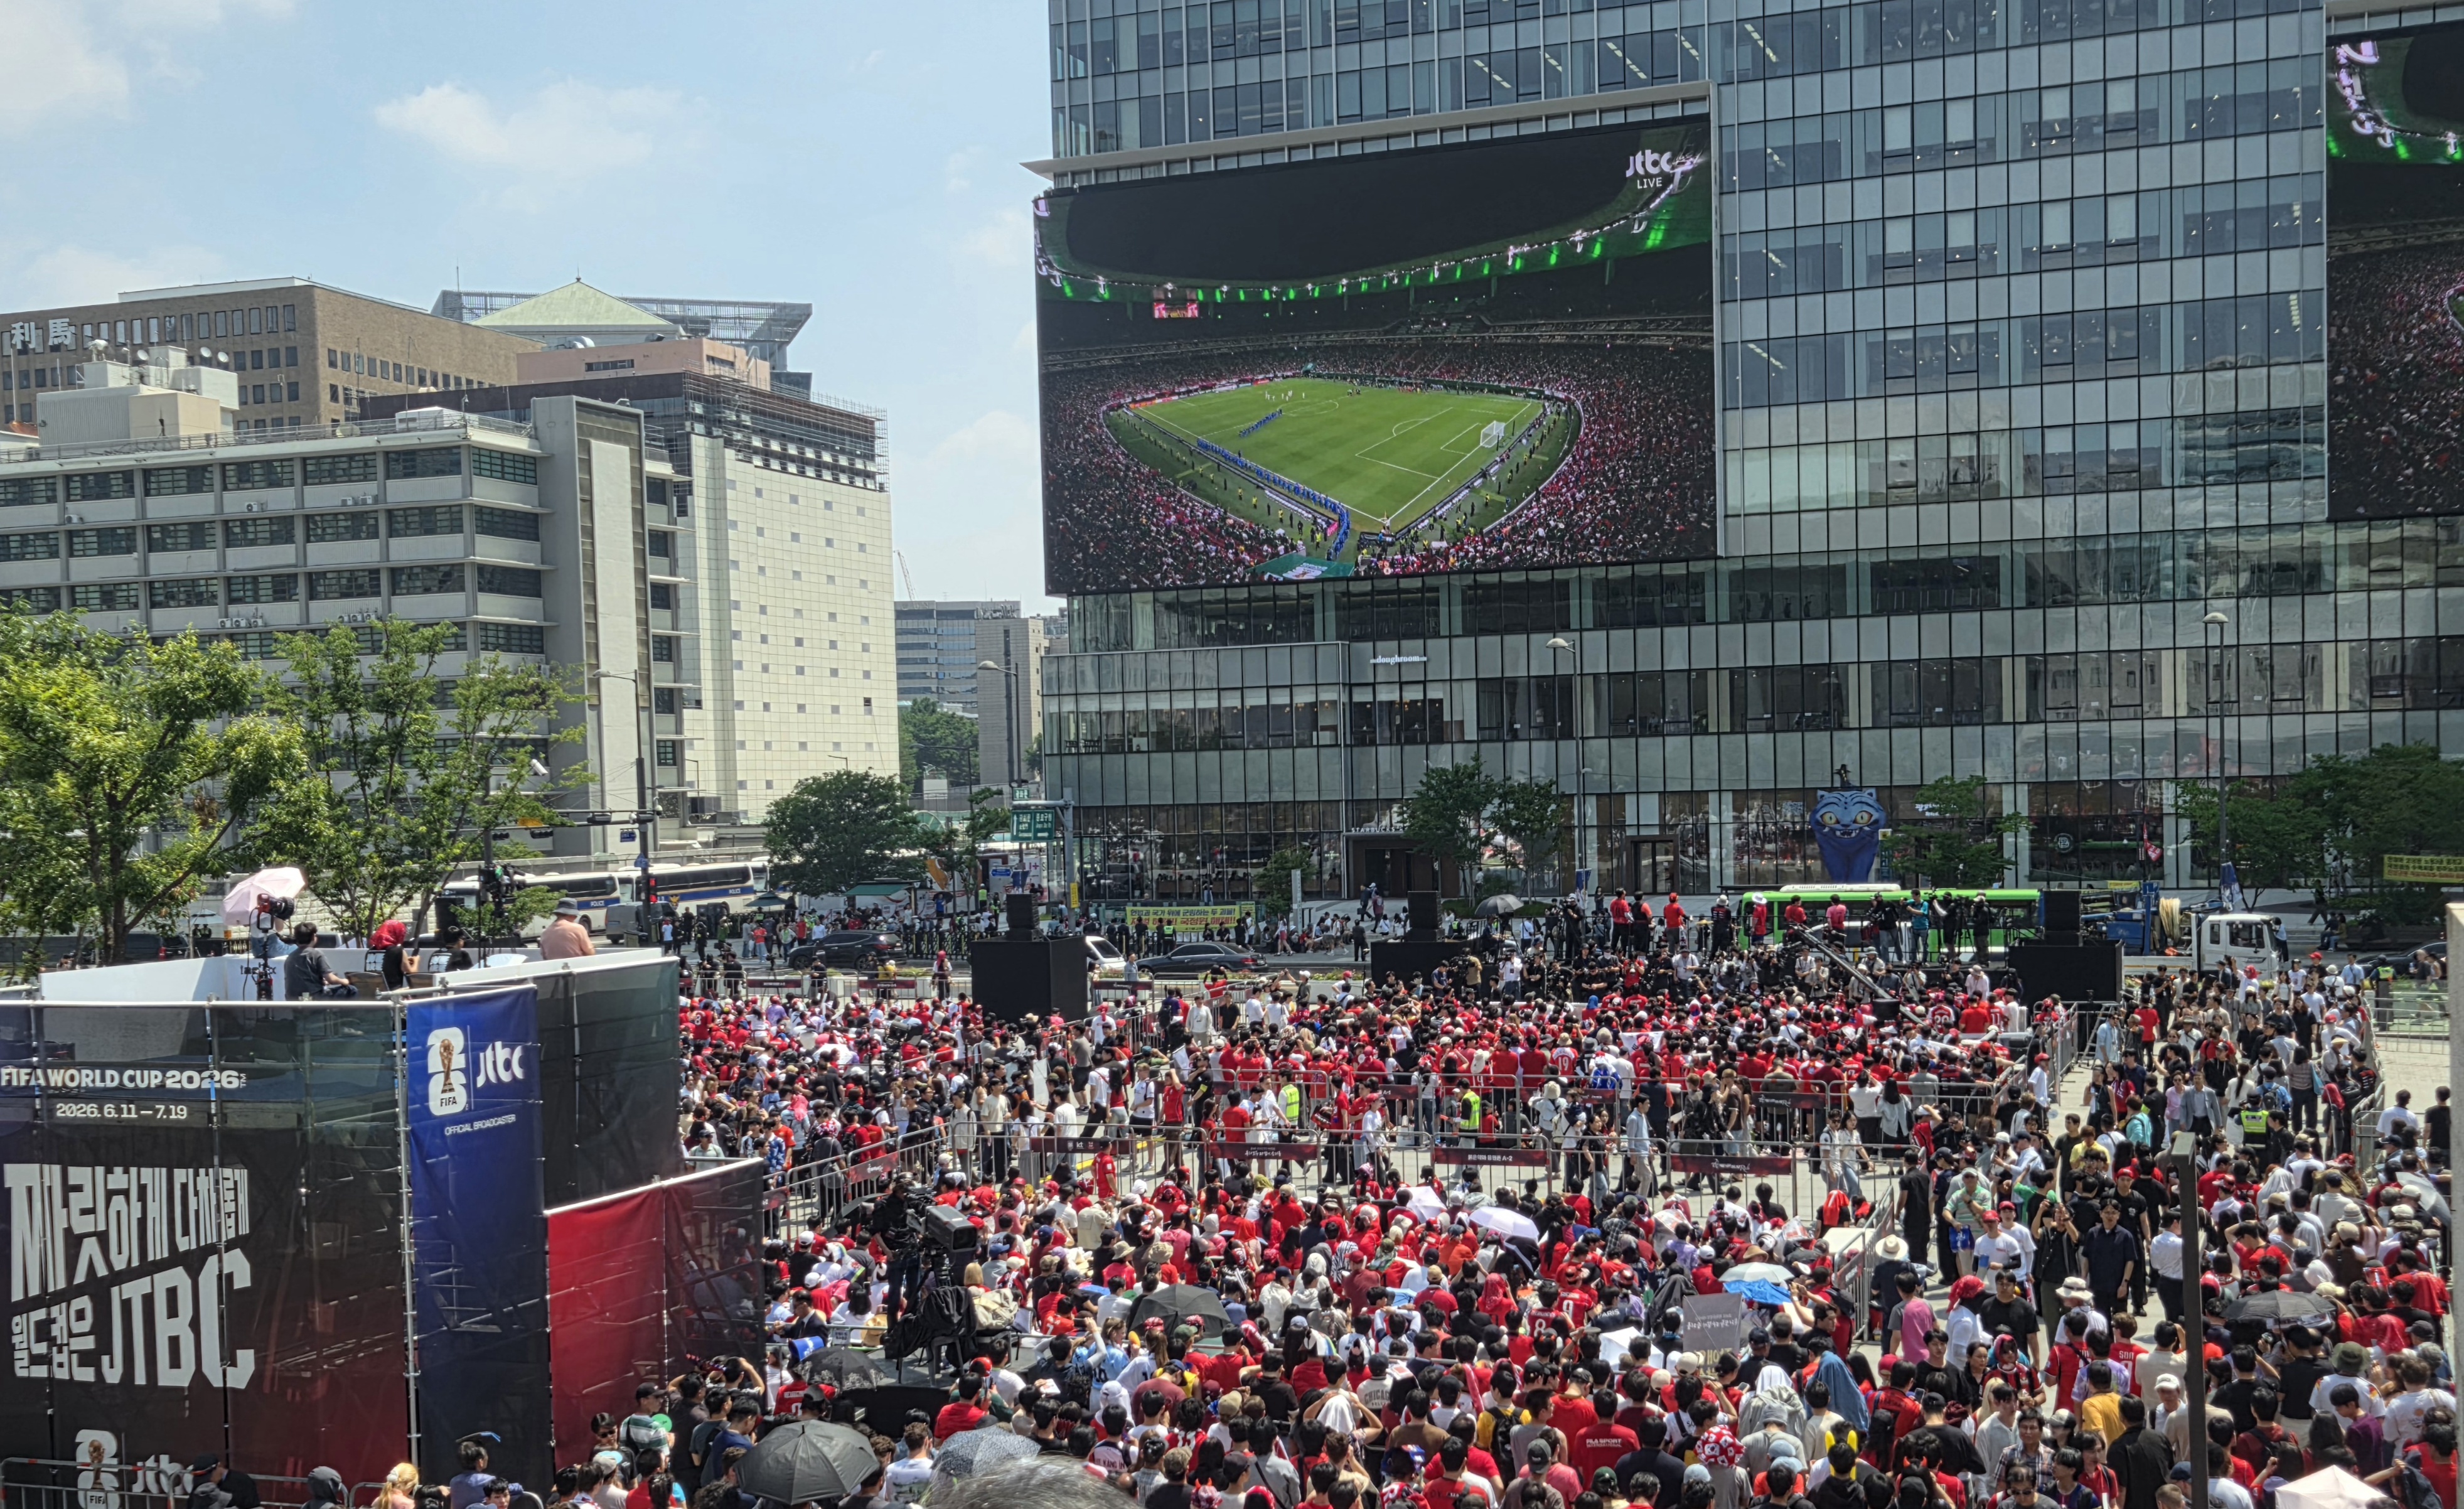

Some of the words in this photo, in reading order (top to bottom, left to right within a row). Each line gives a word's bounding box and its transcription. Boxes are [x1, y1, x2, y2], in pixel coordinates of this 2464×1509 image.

[1637, 177, 1662, 189] LIVE
[11, 318, 71, 349] 利馬
[1376, 655, 1420, 665] doughroom
[1558, 1057, 1569, 1071] 19
[1, 1069, 44, 1086] FIFA
[46, 1069, 120, 1087] WORLD
[122, 1070, 163, 1088] CUP
[165, 1070, 239, 1089] 2026
[440, 1096, 458, 1107] FIFA
[444, 1123, 472, 1136] OFFICIAL
[473, 1114, 516, 1130] BROADCASTER
[4, 1163, 169, 1302] 짜릿하게
[173, 1167, 249, 1252] 다채롭게
[11, 1295, 95, 1382] 월드컵은
[101, 1248, 255, 1389] JTBC
[1597, 1309, 1620, 1319] PARIS
[1535, 1319, 1546, 1337] 8
[2119, 1350, 2135, 1360] SON
[1364, 1389, 1390, 1405] CHICAG
[1103, 1458, 1117, 1469] KANG
